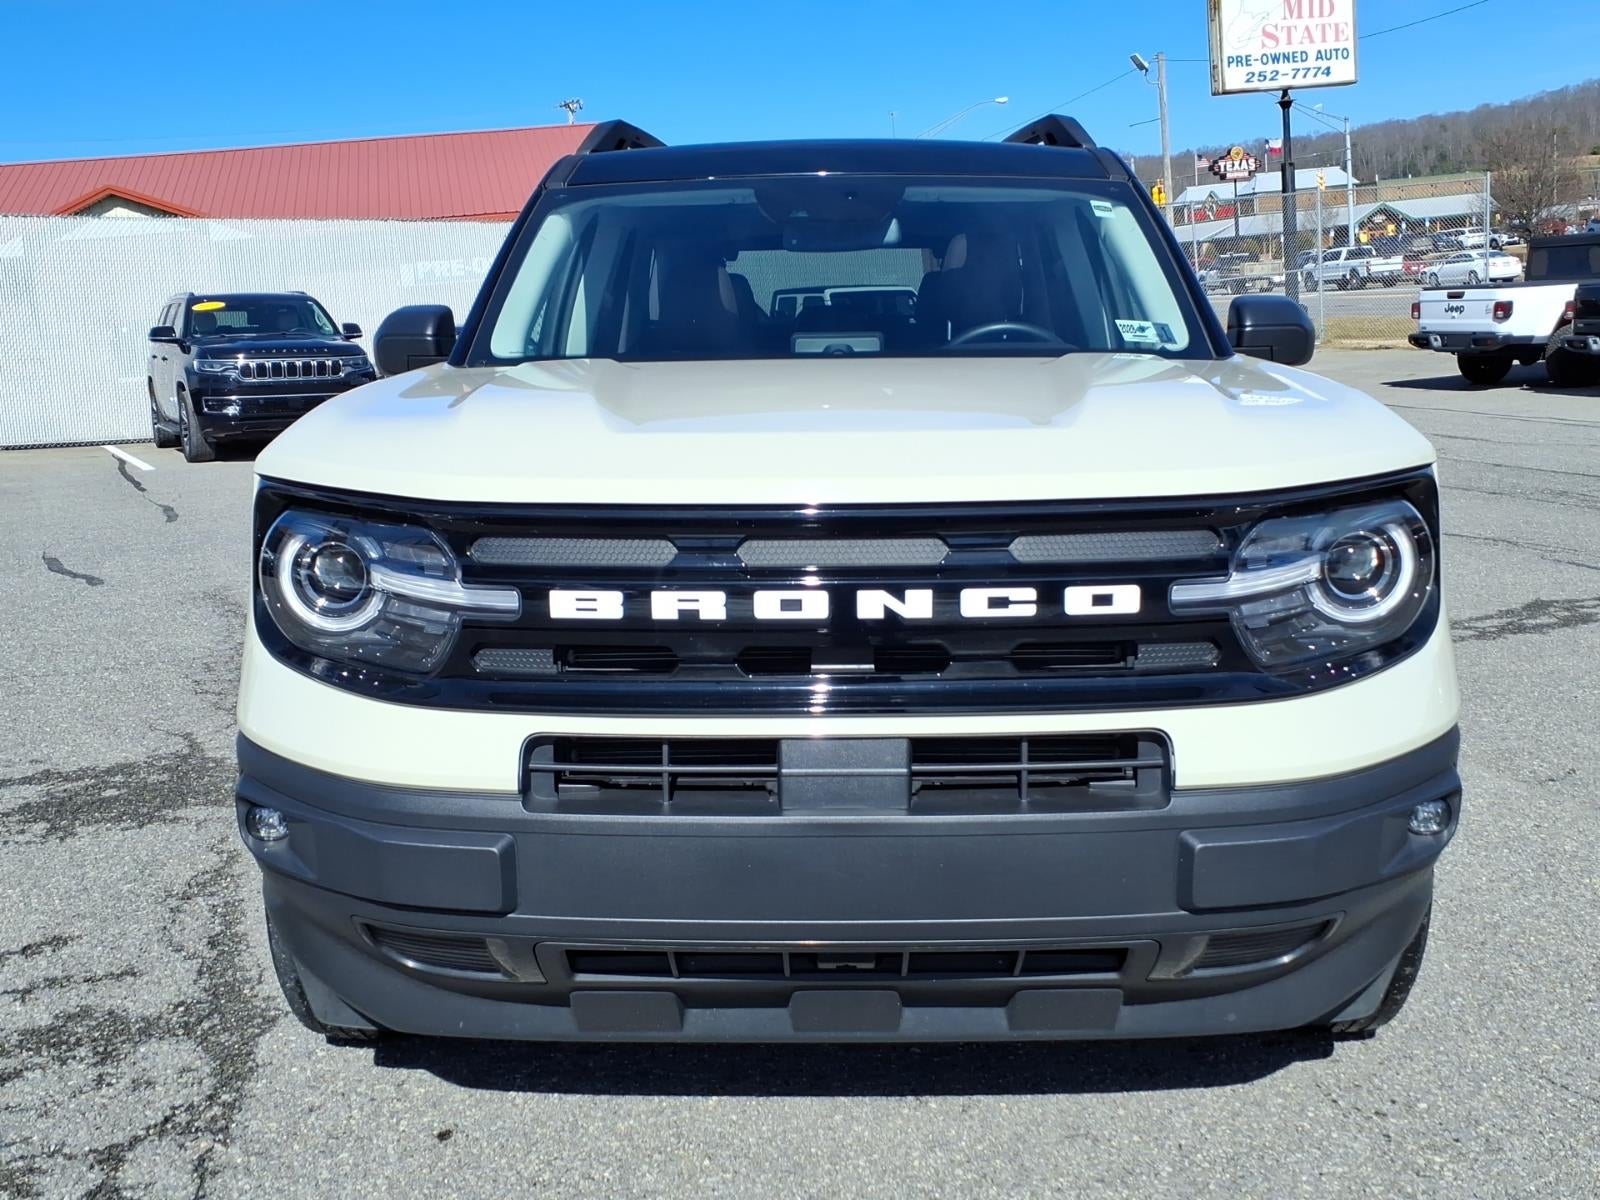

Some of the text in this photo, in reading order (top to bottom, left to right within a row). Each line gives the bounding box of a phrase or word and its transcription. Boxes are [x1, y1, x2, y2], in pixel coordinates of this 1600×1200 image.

[1281, 0, 1334, 20] MID
[1261, 22, 1349, 48] STATE
[1227, 48, 1350, 68] PRE-OWNED AUTO
[1244, 66, 1331, 83] 252-7774
[1218, 158, 1256, 172] TEXAS
[1444, 303, 1465, 315] Jeep
[549, 585, 1141, 620] BRONCO
